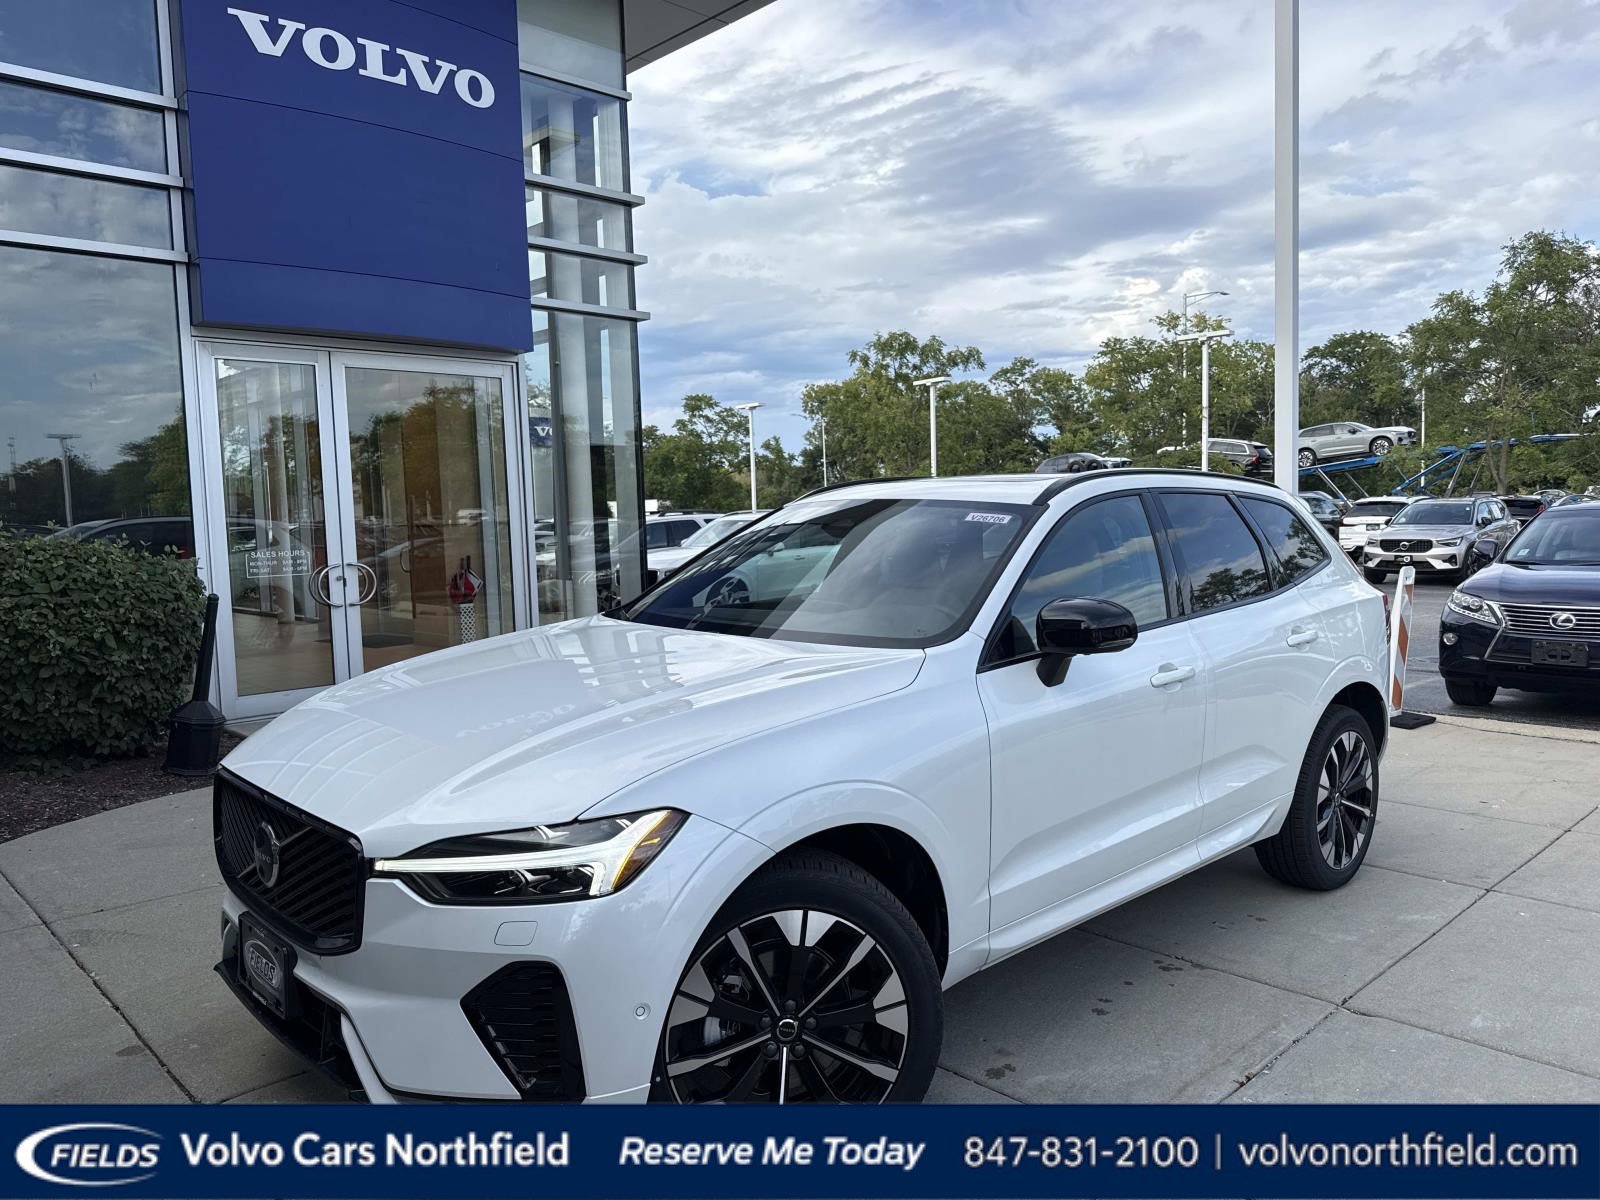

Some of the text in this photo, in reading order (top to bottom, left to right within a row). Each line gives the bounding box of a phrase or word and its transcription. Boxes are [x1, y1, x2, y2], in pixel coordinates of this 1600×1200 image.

[227, 7, 495, 108] VOLVO
[278, 549, 305, 558] HOURS
[249, 947, 276, 985] FIELDS
